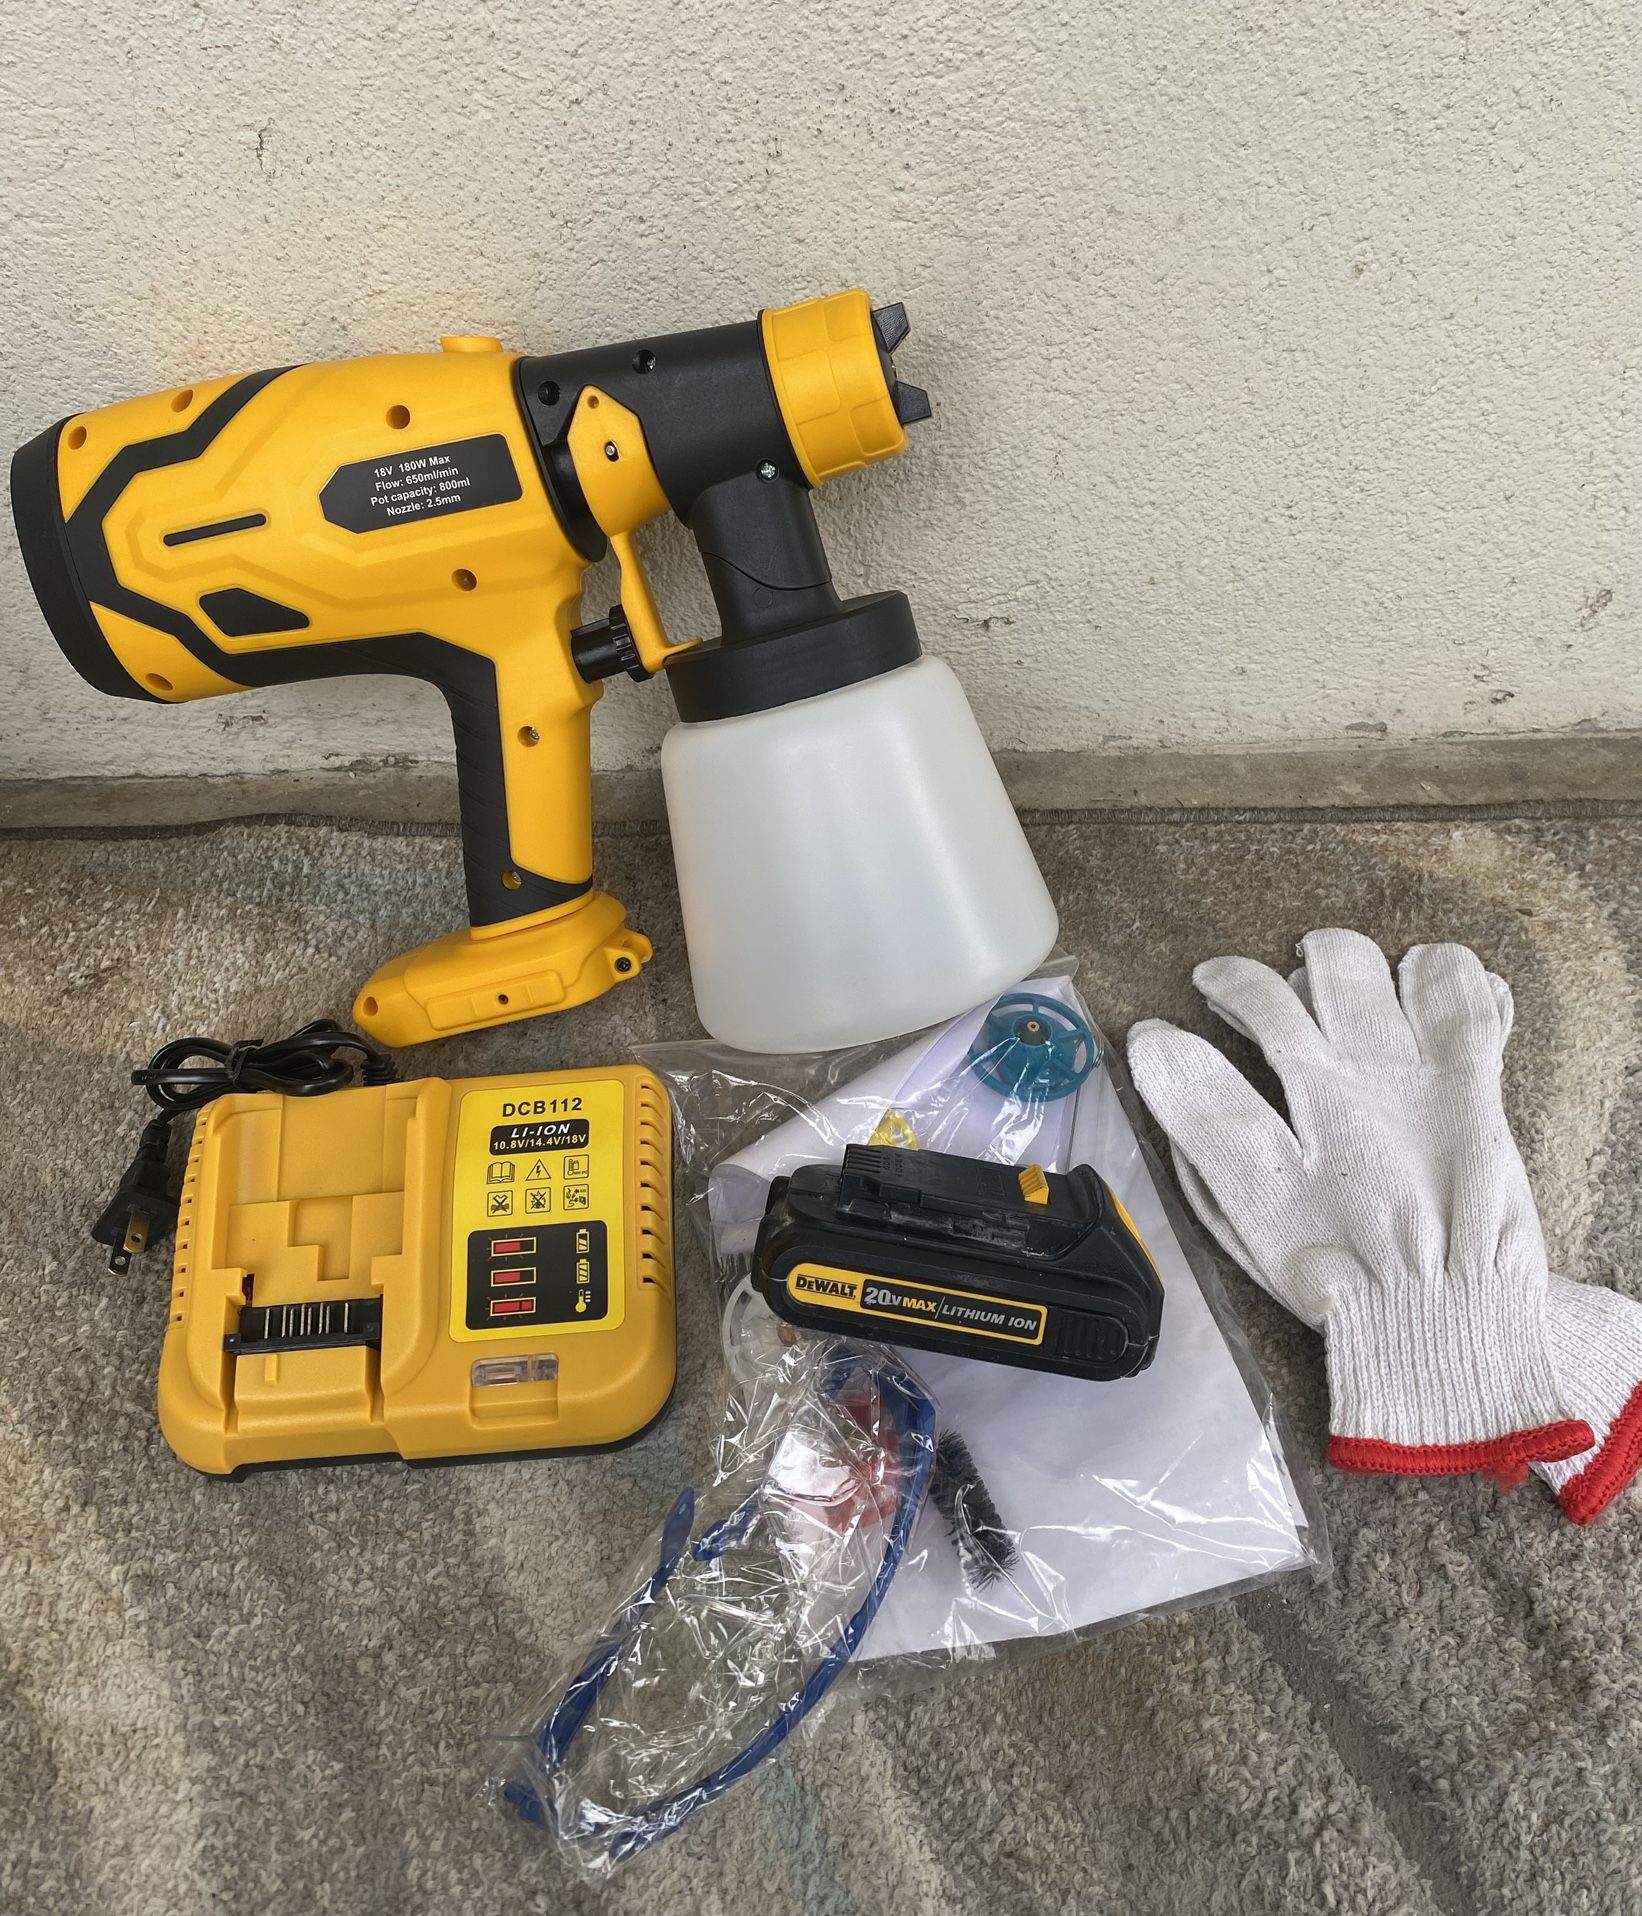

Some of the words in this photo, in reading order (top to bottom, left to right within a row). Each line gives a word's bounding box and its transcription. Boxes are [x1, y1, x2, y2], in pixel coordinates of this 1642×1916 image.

[374, 466, 393, 478] 18V
[398, 458, 427, 473] 180W
[429, 455, 451, 466] Max
[375, 479, 404, 492] Flow:
[405, 467, 459, 485] 650ml/min
[370, 495, 389, 506] Pot
[391, 485, 437, 502] capacity:
[439, 477, 470, 492] 800ml
[387, 502, 424, 516] Nozzle:
[427, 494, 461, 508] 2.5mm
[502, 1097, 582, 1117] DCB112
[511, 1123, 570, 1138] LI-ION
[493, 1134, 586, 1150] 10.8V/14.4V/18V
[1008, 1317, 1037, 1330] ION
